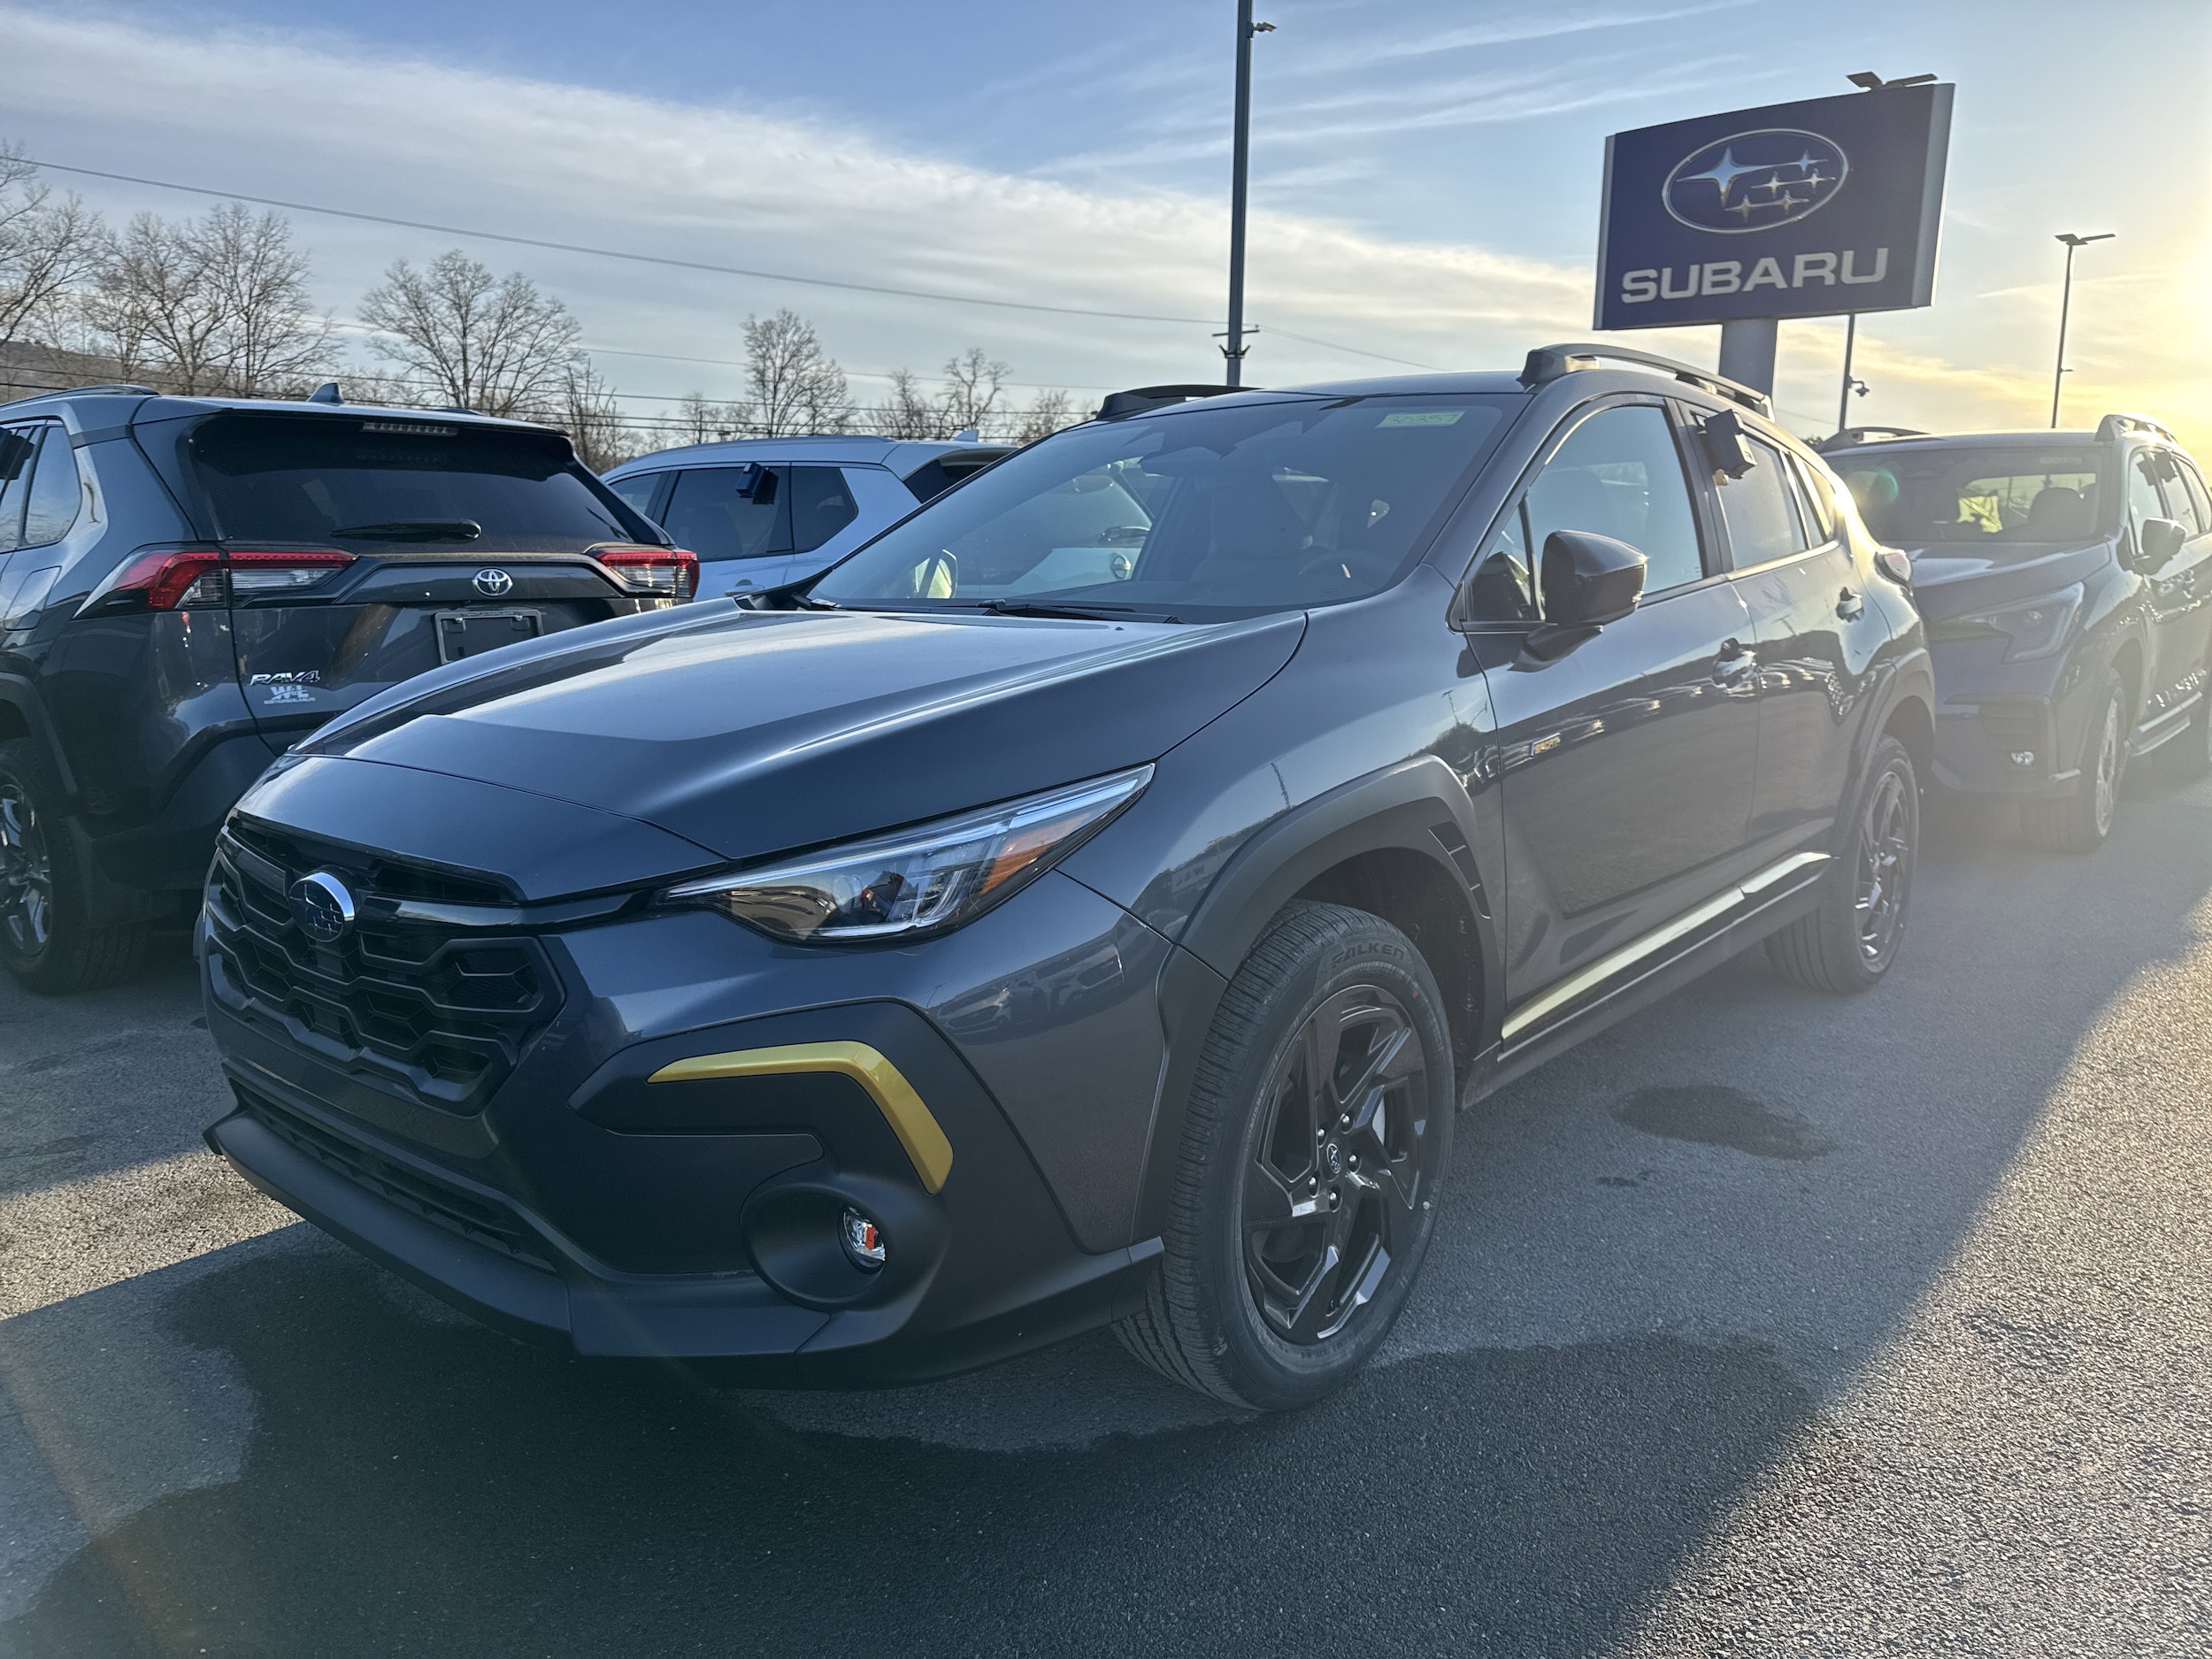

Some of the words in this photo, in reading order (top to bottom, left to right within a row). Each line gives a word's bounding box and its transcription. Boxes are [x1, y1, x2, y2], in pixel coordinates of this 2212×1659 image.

[1620, 247, 1890, 304] SUBARU
[249, 670, 320, 686] RAV4
[1330, 942, 1405, 970] FALKEN
